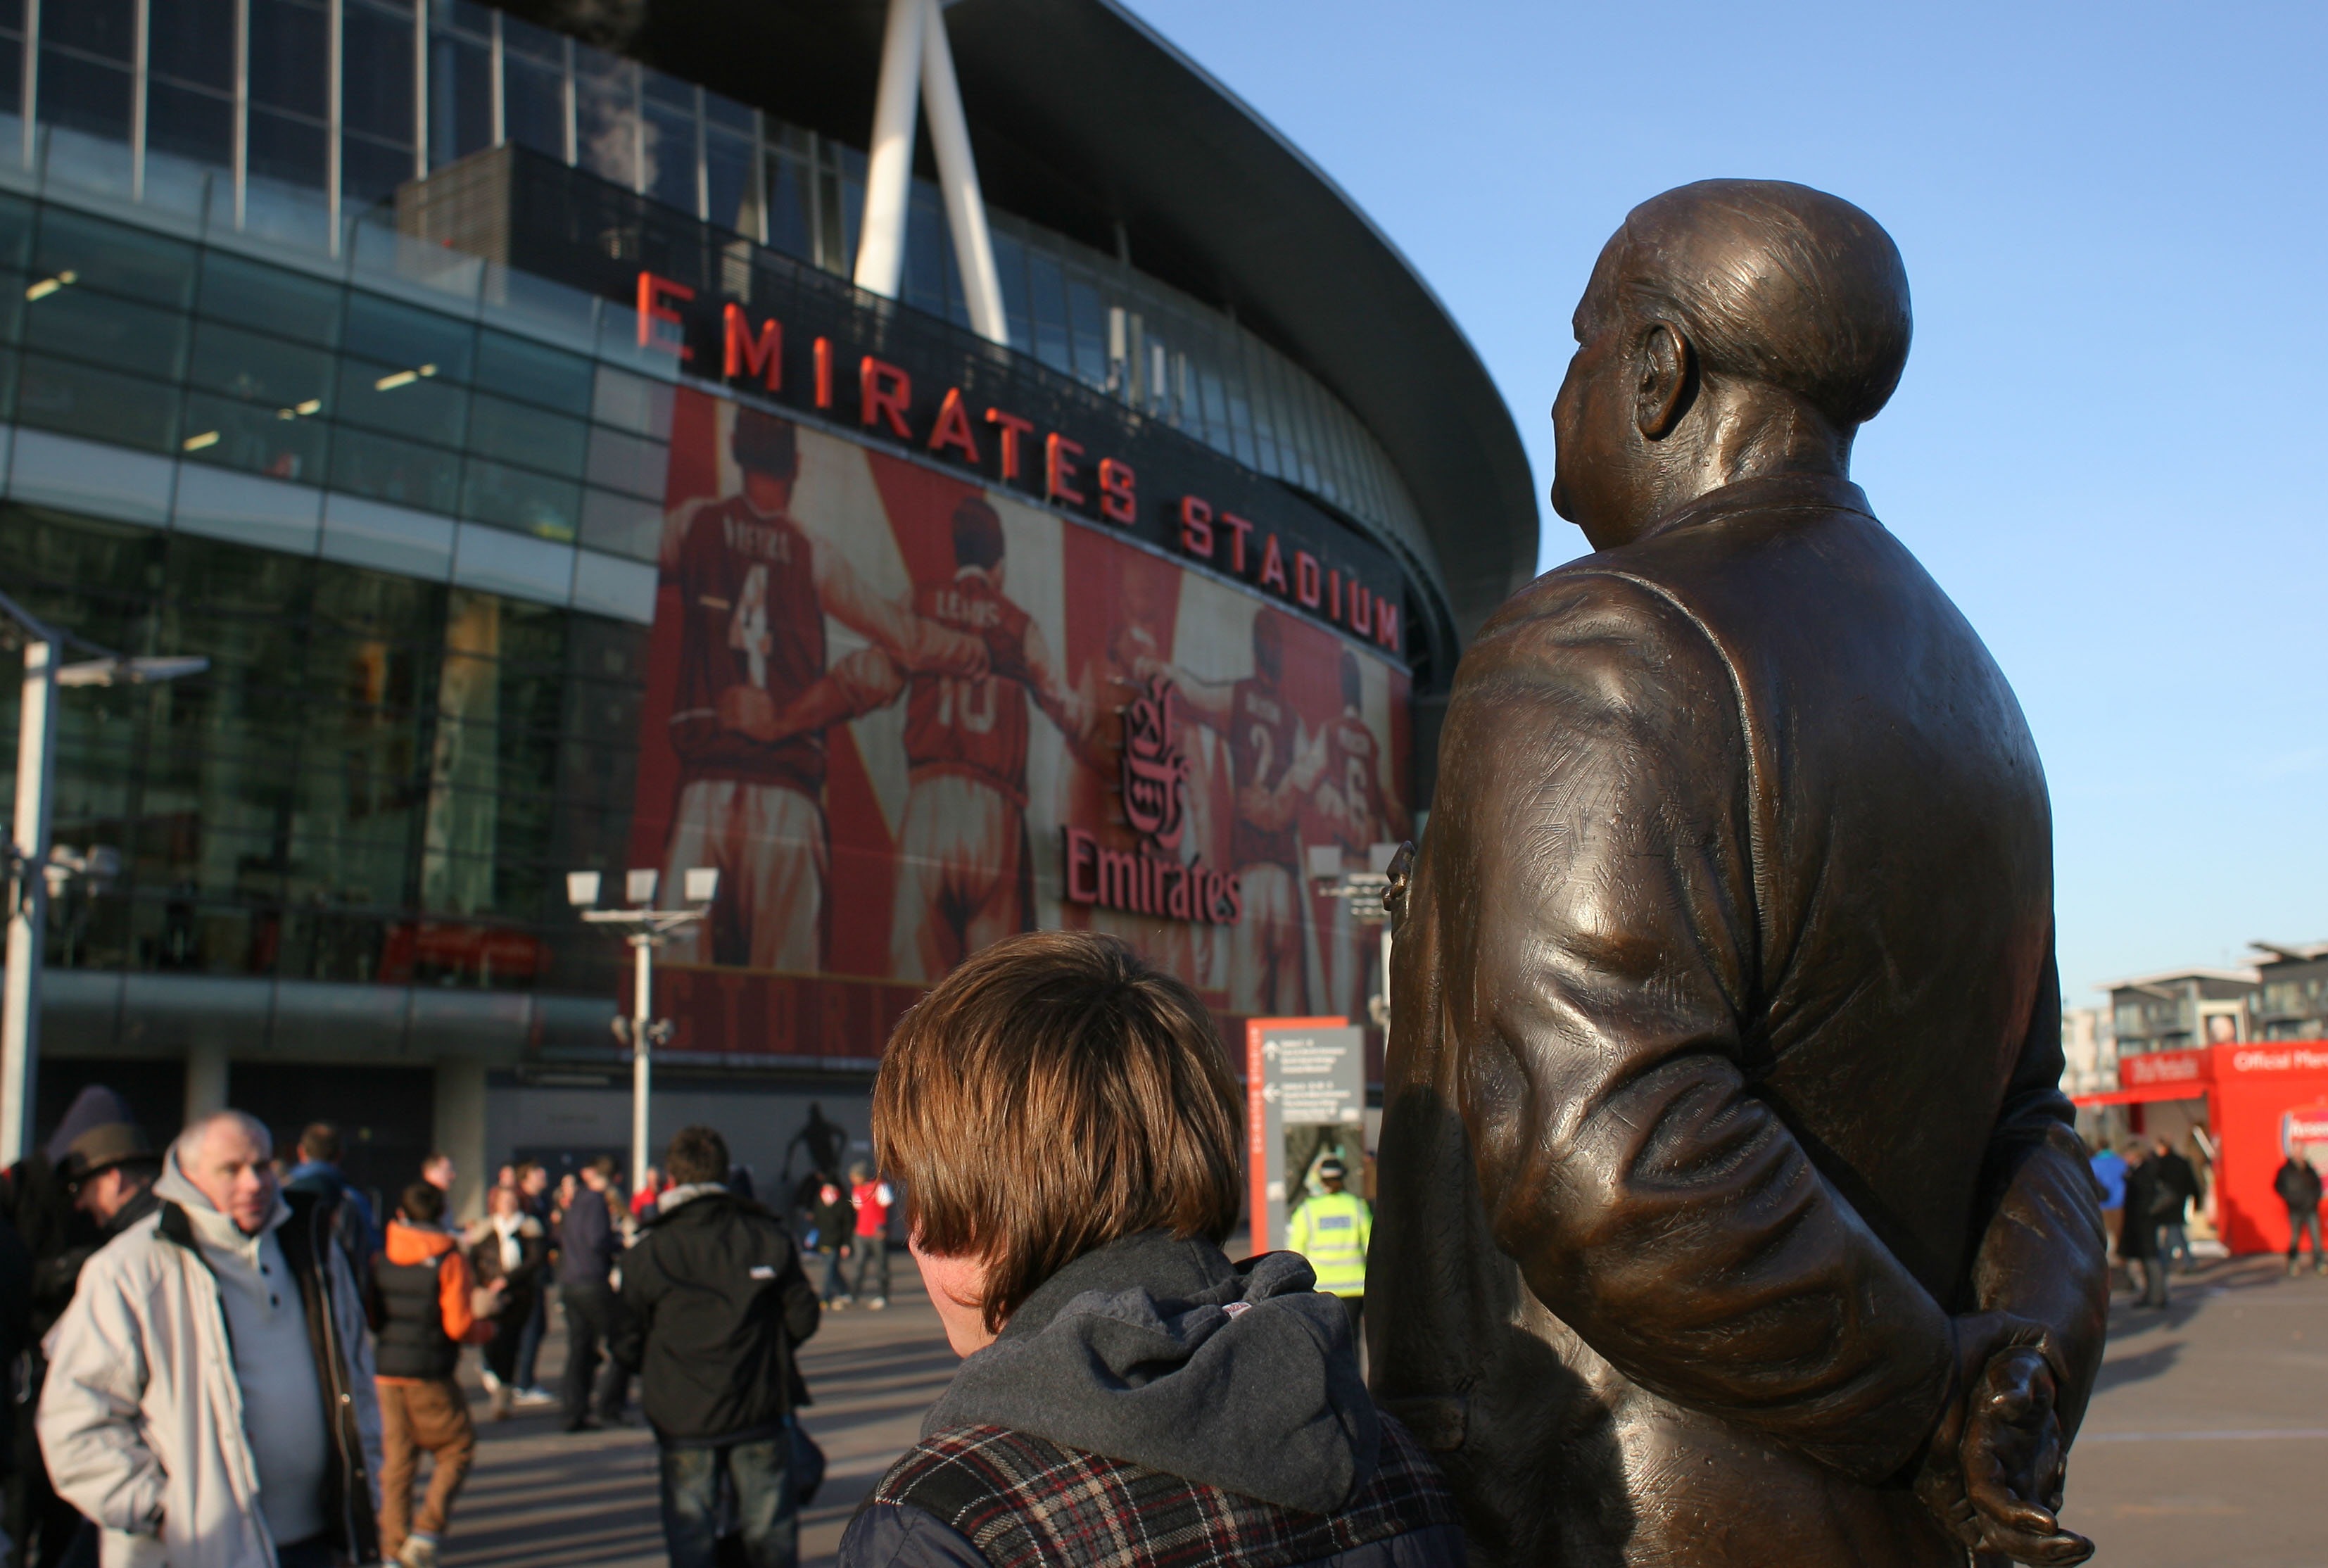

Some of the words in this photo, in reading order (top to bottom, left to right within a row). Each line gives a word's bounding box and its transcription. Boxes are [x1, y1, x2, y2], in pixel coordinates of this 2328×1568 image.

[637, 270, 1137, 525] EMIRATES
[1179, 495, 1399, 651] STADIUM
[1064, 826, 1244, 925] Emirates
[2233, 1049, 2292, 1072] Official
